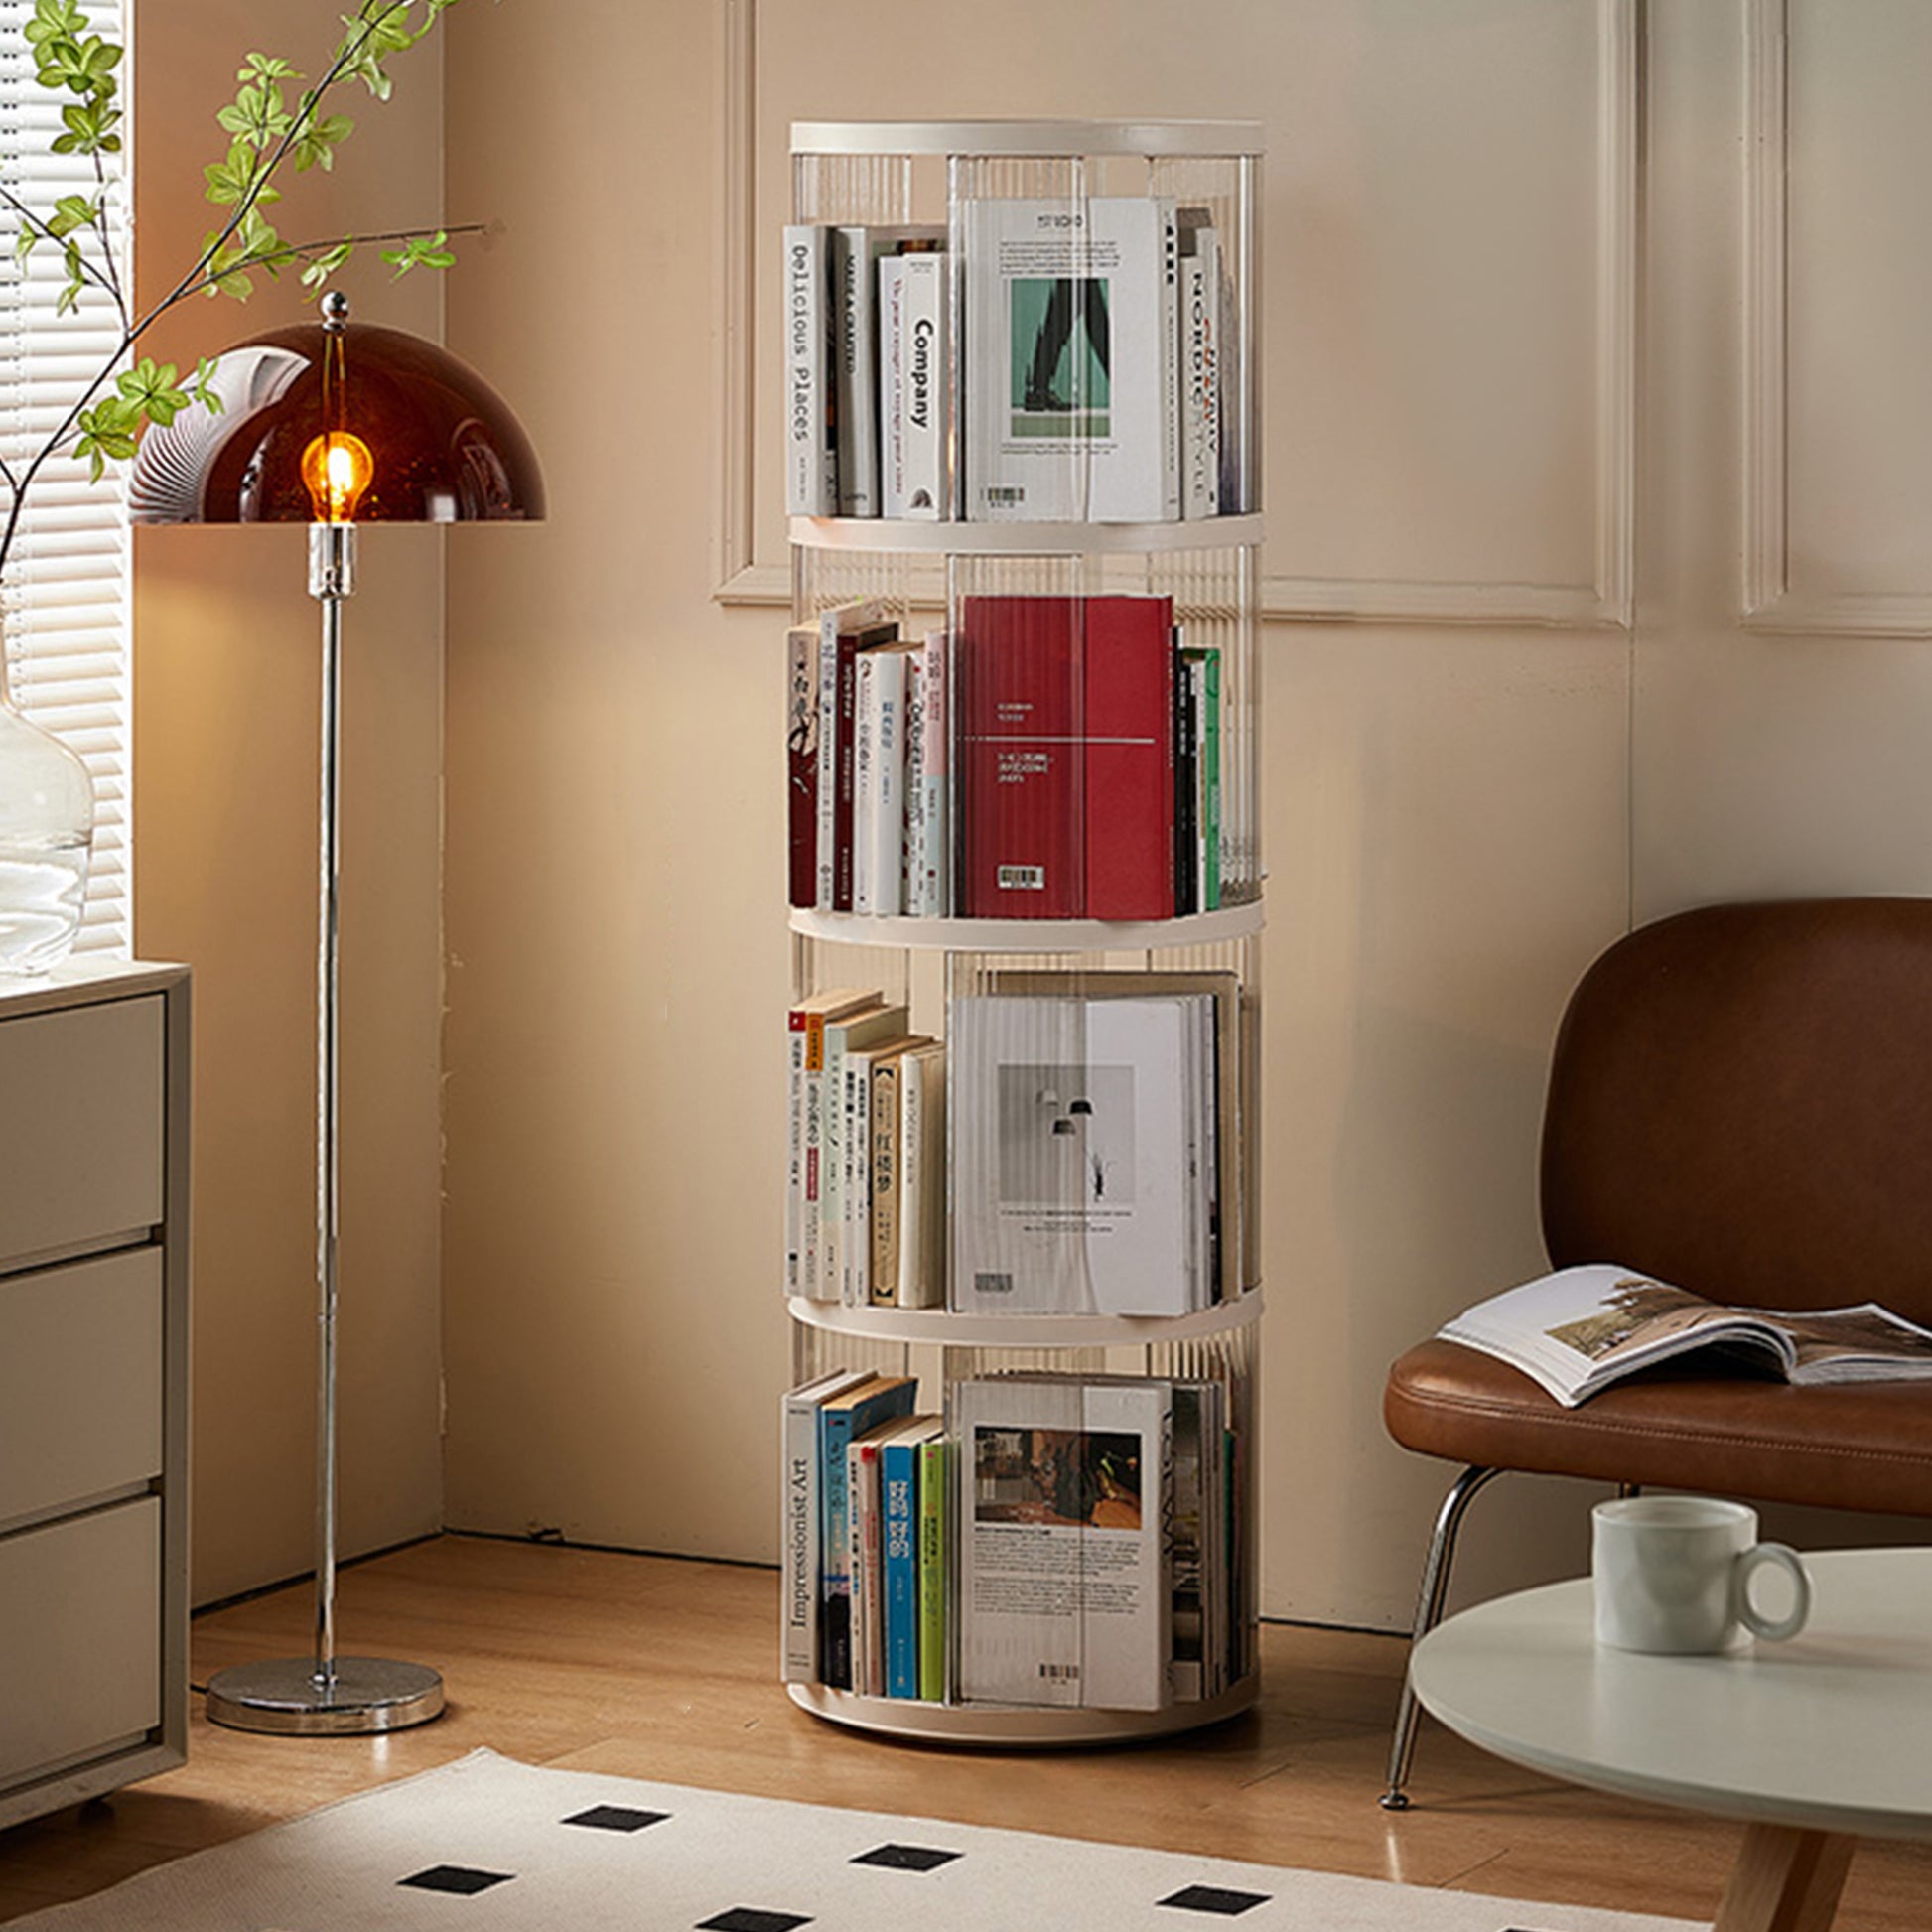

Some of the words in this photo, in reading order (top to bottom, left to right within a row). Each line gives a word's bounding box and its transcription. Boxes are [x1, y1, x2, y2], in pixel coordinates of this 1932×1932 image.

[792, 245, 809, 356] Delicious
[1193, 273, 1202, 405] NORDIC
[794, 366, 810, 442] Places
[910, 319, 934, 429] Company
[791, 1459, 807, 1491] Art
[791, 1494, 810, 1628] Impressionist
